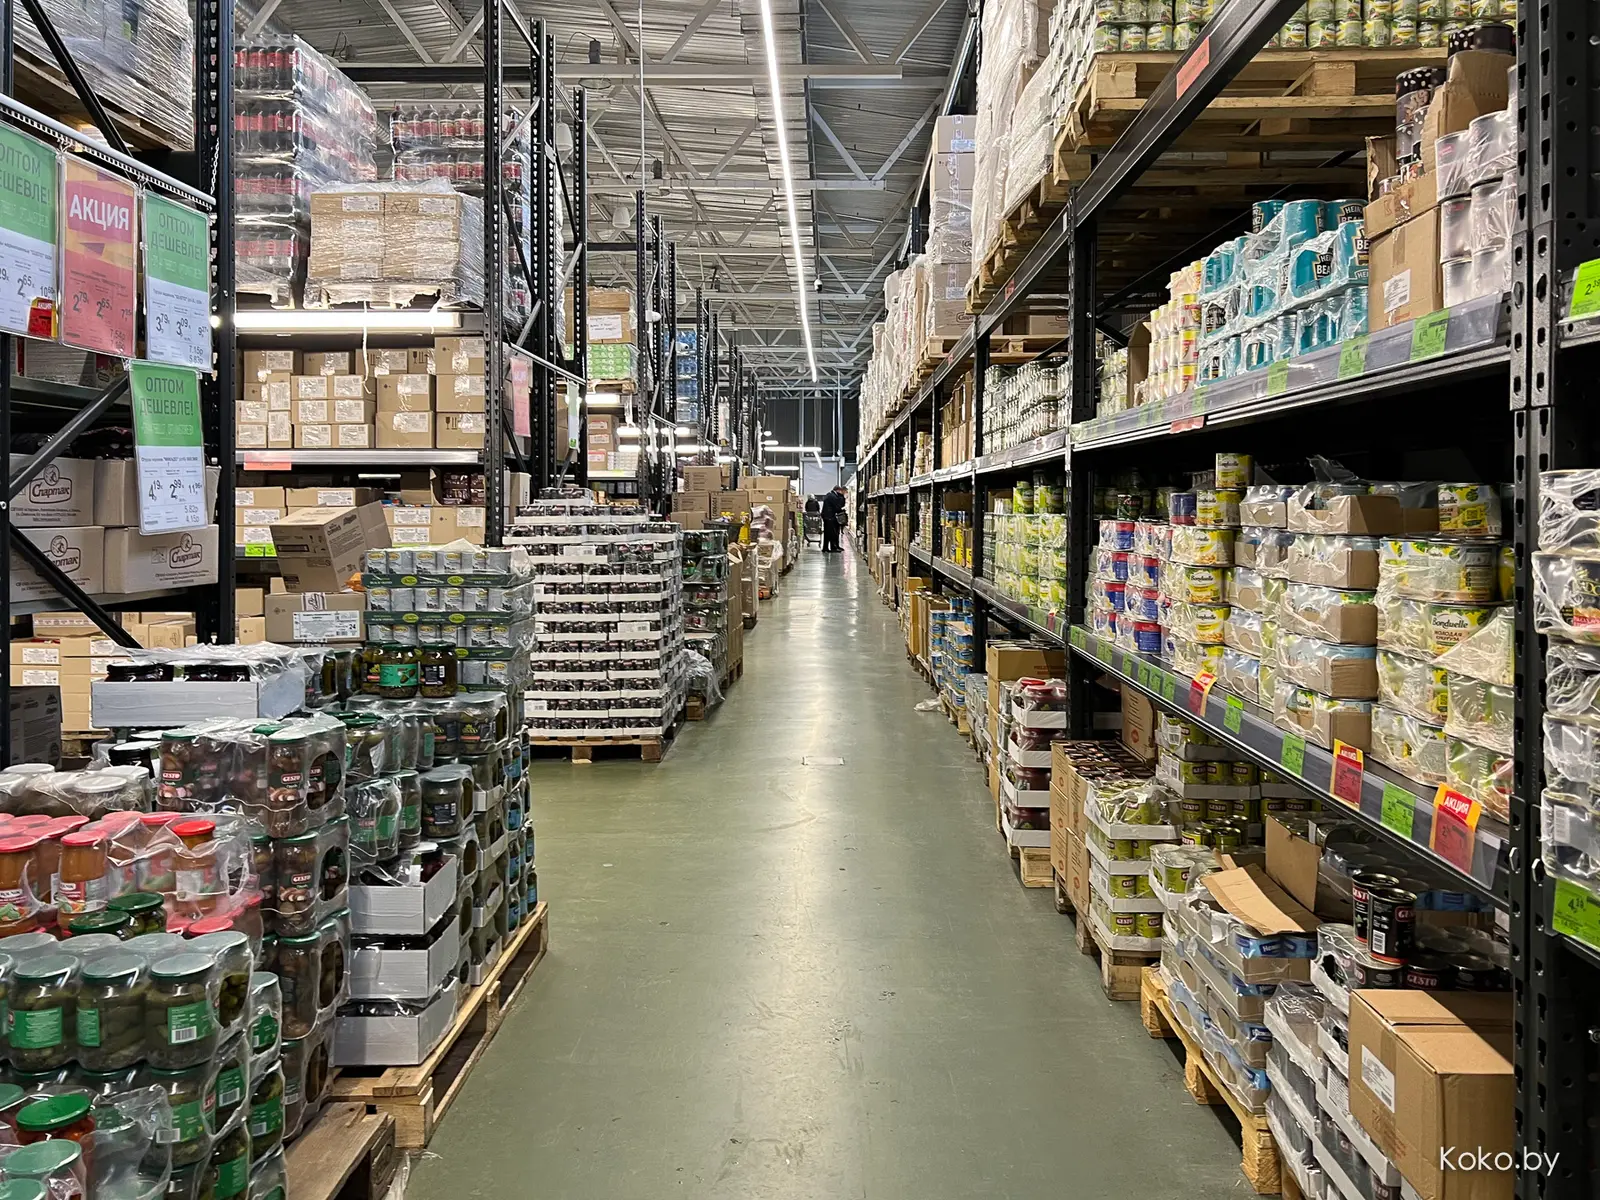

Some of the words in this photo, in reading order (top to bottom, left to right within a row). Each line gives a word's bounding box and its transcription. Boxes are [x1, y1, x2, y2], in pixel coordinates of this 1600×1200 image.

[69, 194, 130, 231] АКЦИЯ
[158, 212, 195, 238] ОПТОМ
[150, 231, 204, 261] ДЕШЕВЛЕ!
[145, 377, 184, 394] ОПТОМ
[140, 398, 194, 416] ДЕШЕВЛЕ!
[31, 482, 70, 499] Спартак
[1431, 616, 1469, 630] Bonduelle
[1443, 796, 1470, 814] АКЦИЯ
[1406, 974, 1438, 986] GUSTO
